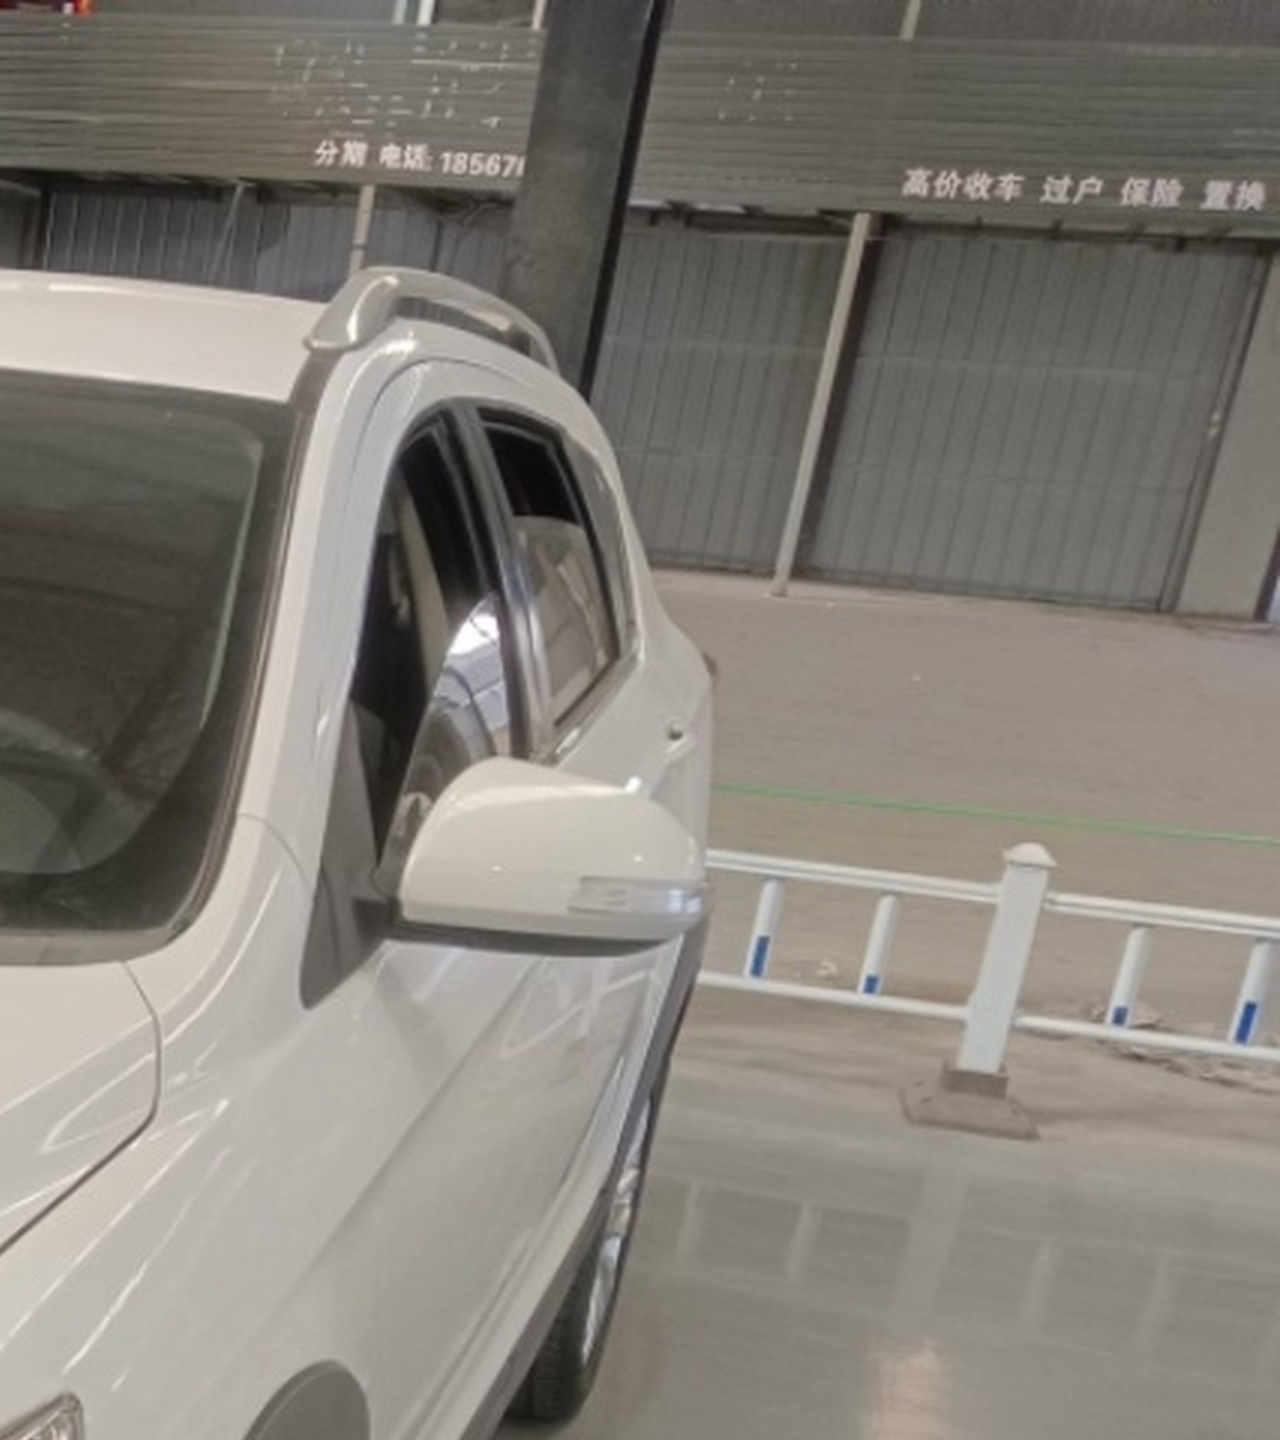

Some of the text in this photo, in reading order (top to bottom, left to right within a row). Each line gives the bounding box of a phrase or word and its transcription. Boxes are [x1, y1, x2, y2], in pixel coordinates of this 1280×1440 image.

[315, 140, 368, 168] 分期
[902, 168, 1266, 211] 高价收车 过户 保险 置换
